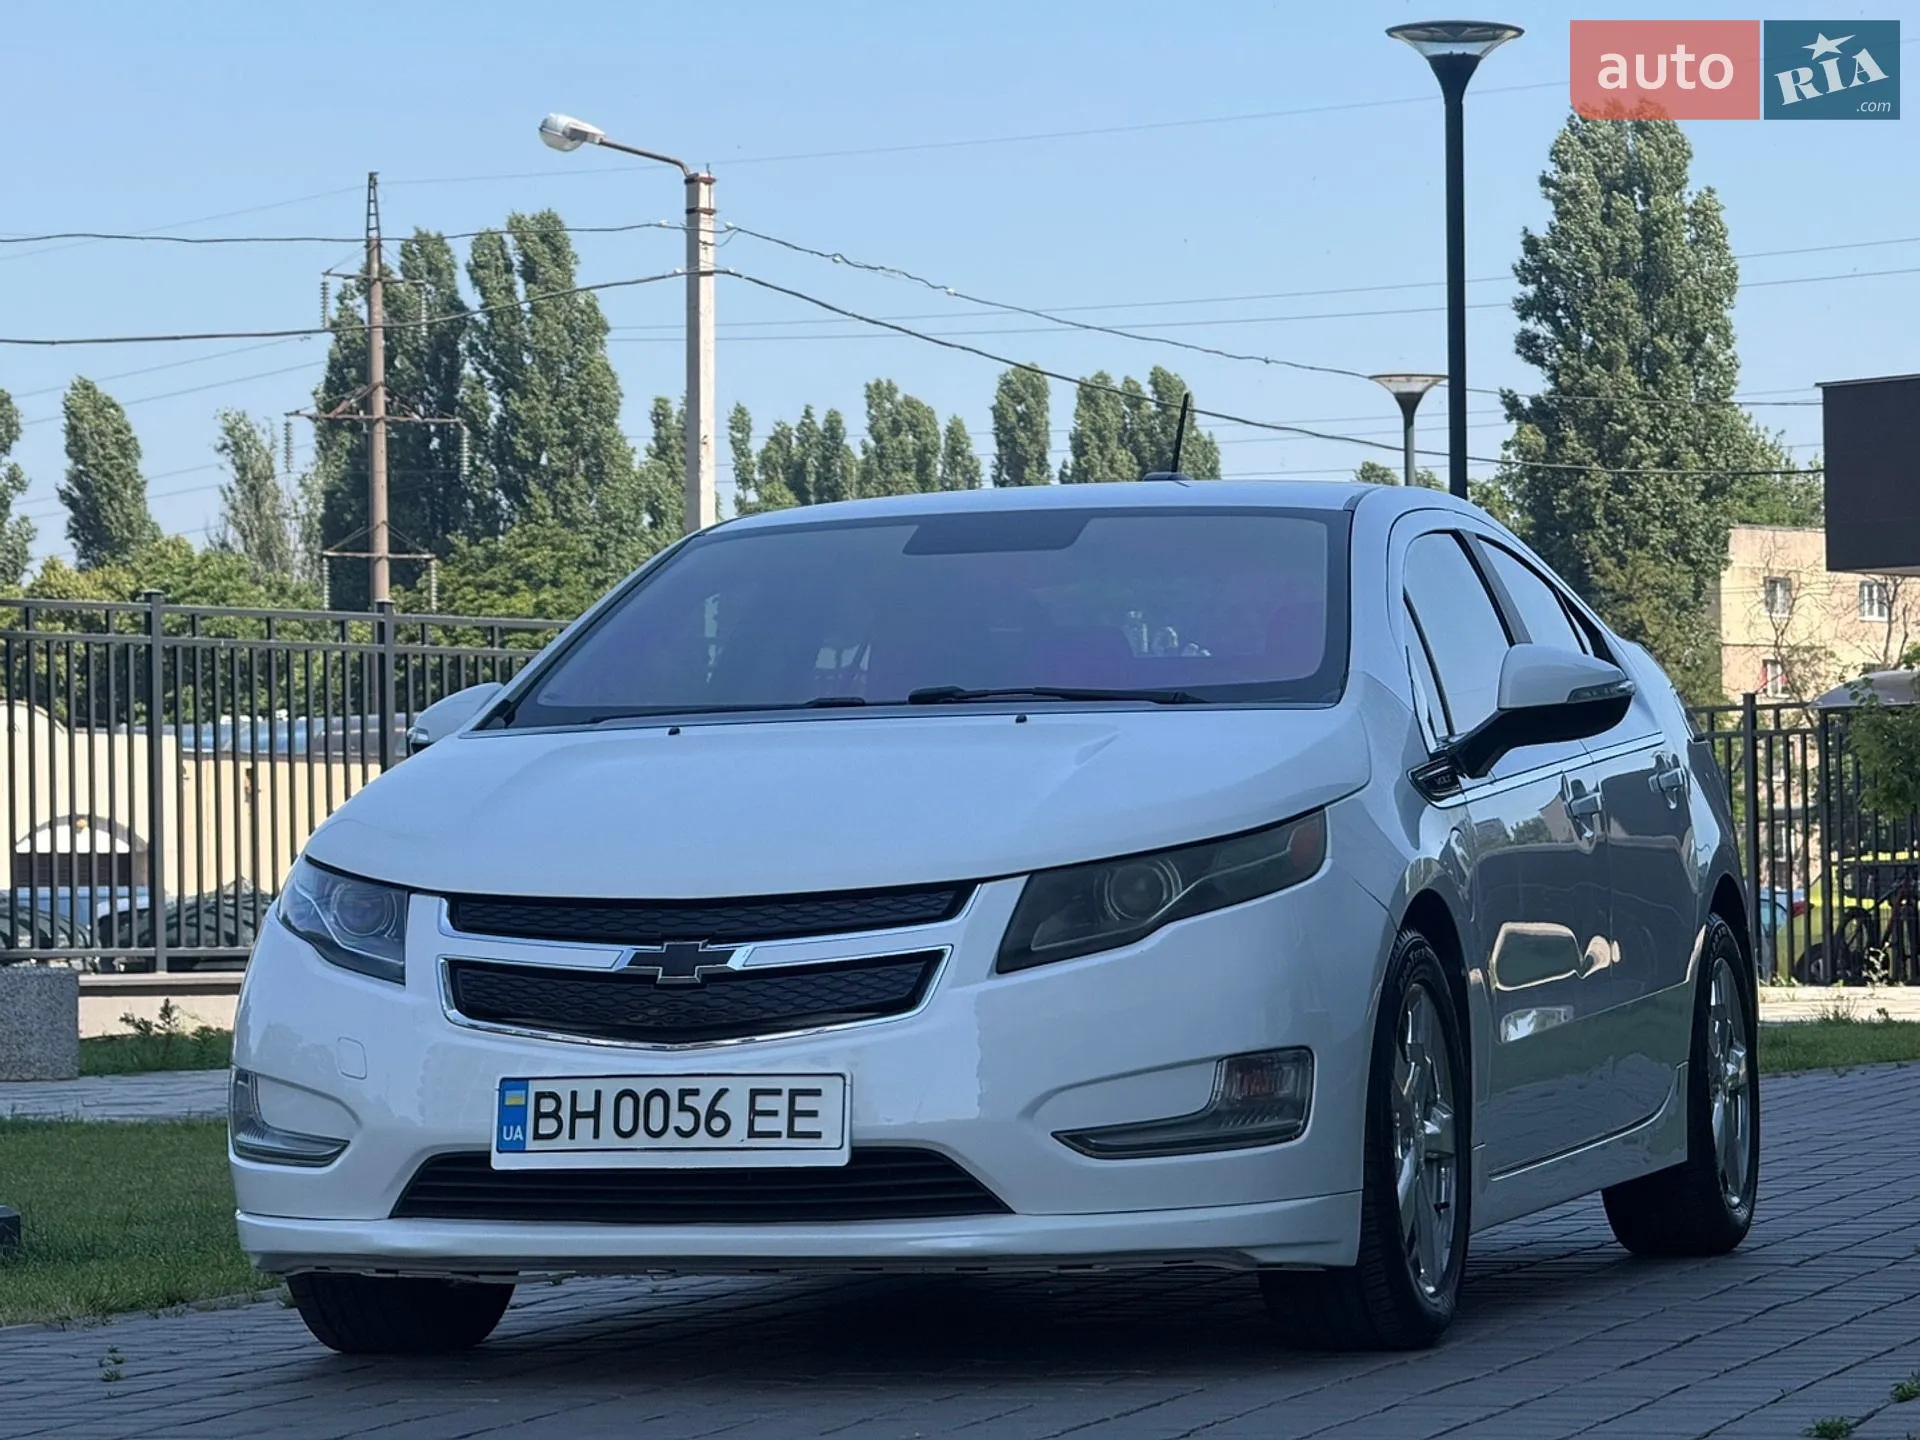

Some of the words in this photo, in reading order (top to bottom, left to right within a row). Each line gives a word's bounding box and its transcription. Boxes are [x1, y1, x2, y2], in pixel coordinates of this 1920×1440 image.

[532, 1089, 601, 1141] BH
[613, 1087, 732, 1139] 0056
[747, 1087, 823, 1139] EE
[502, 1125, 524, 1142] UA
